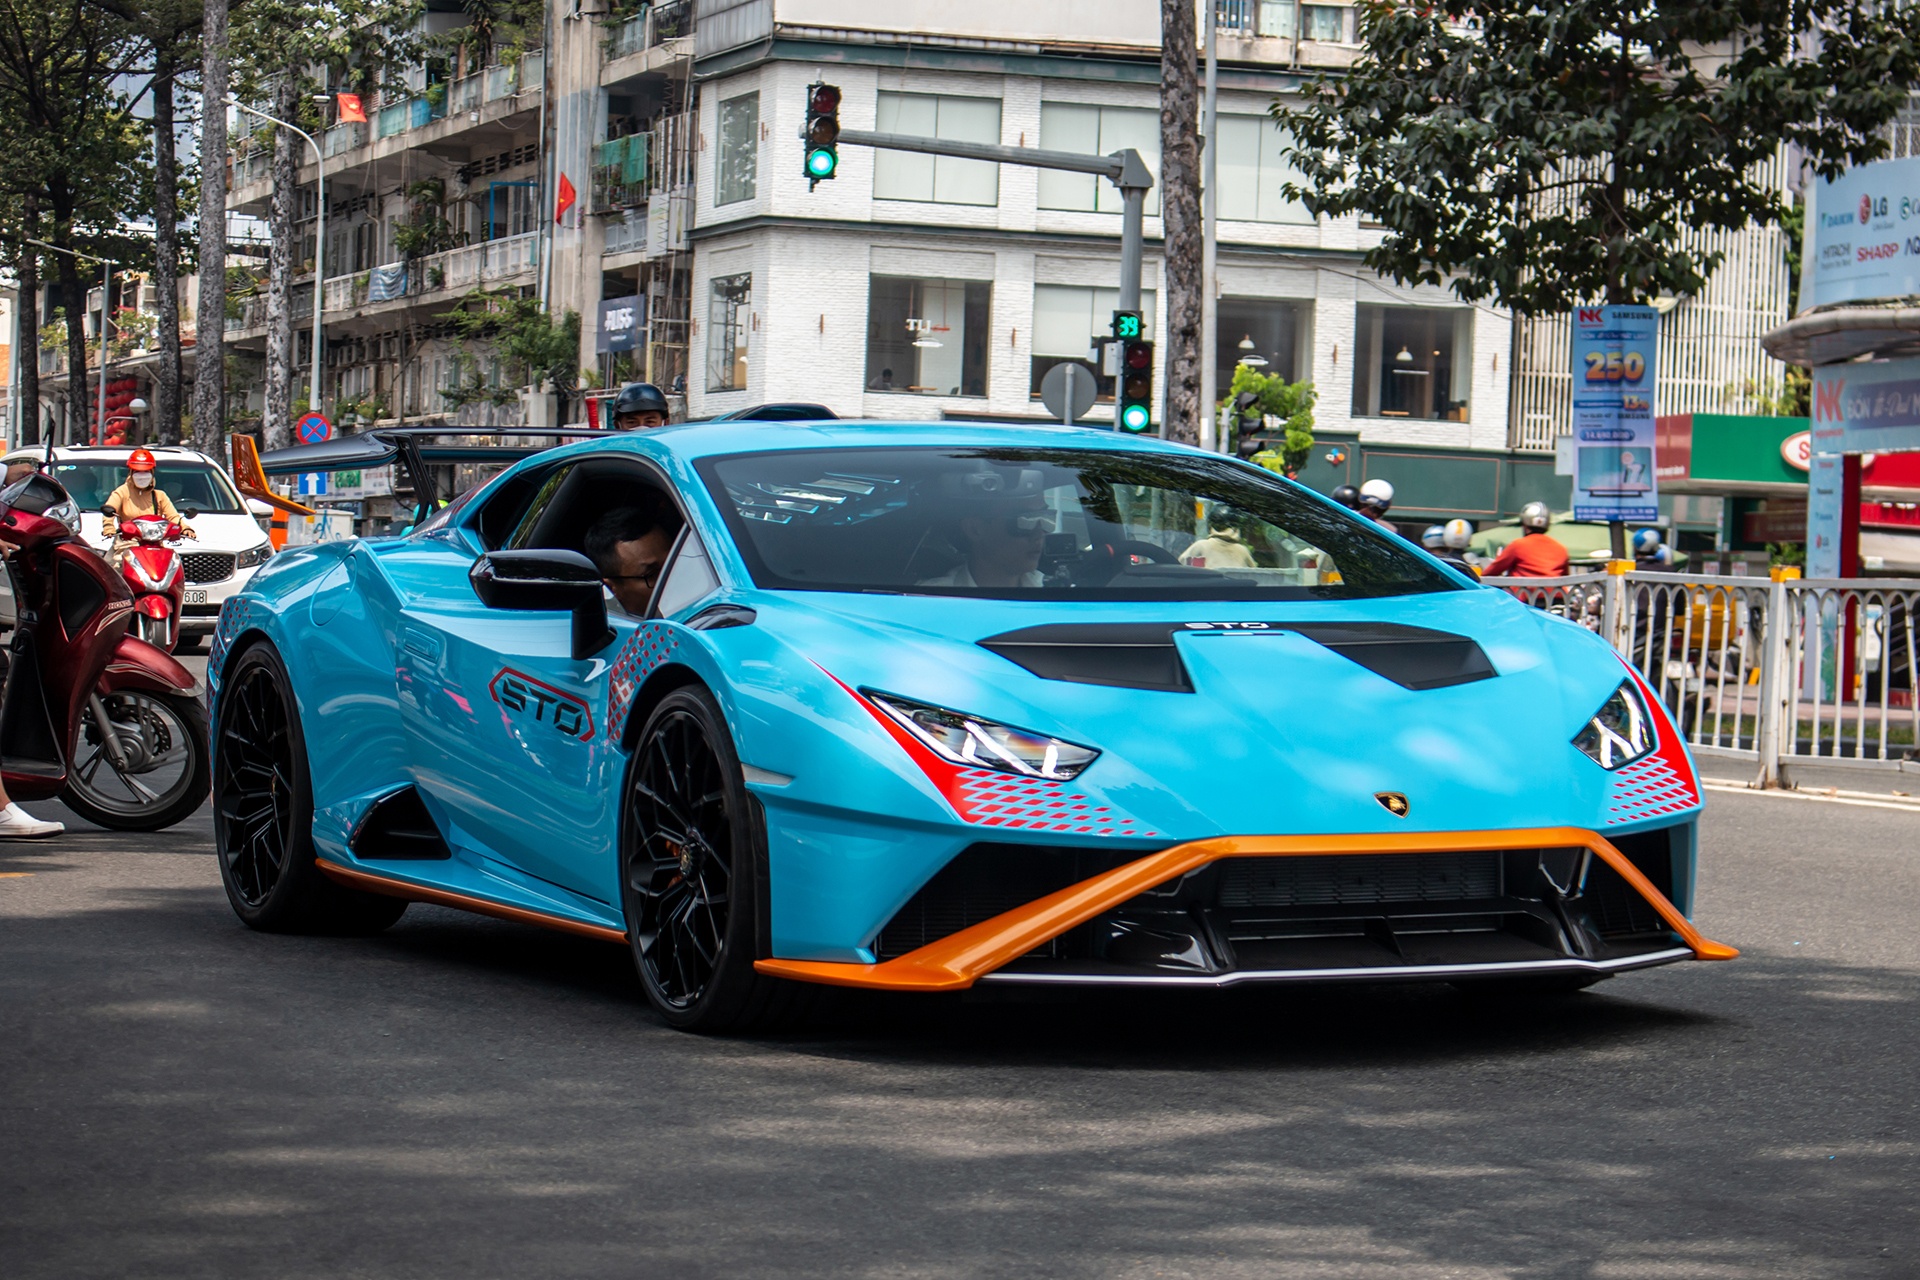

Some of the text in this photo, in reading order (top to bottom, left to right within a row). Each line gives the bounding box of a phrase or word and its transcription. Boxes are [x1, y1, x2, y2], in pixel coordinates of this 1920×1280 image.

[1873, 196, 1888, 217] LG
[1857, 243, 1899, 262] SHARP
[1579, 309, 1603, 322] NK
[1119, 316, 1138, 337] 39
[1585, 352, 1645, 381] 250
[1816, 379, 1846, 423] NK
[501, 677, 582, 736] STO
